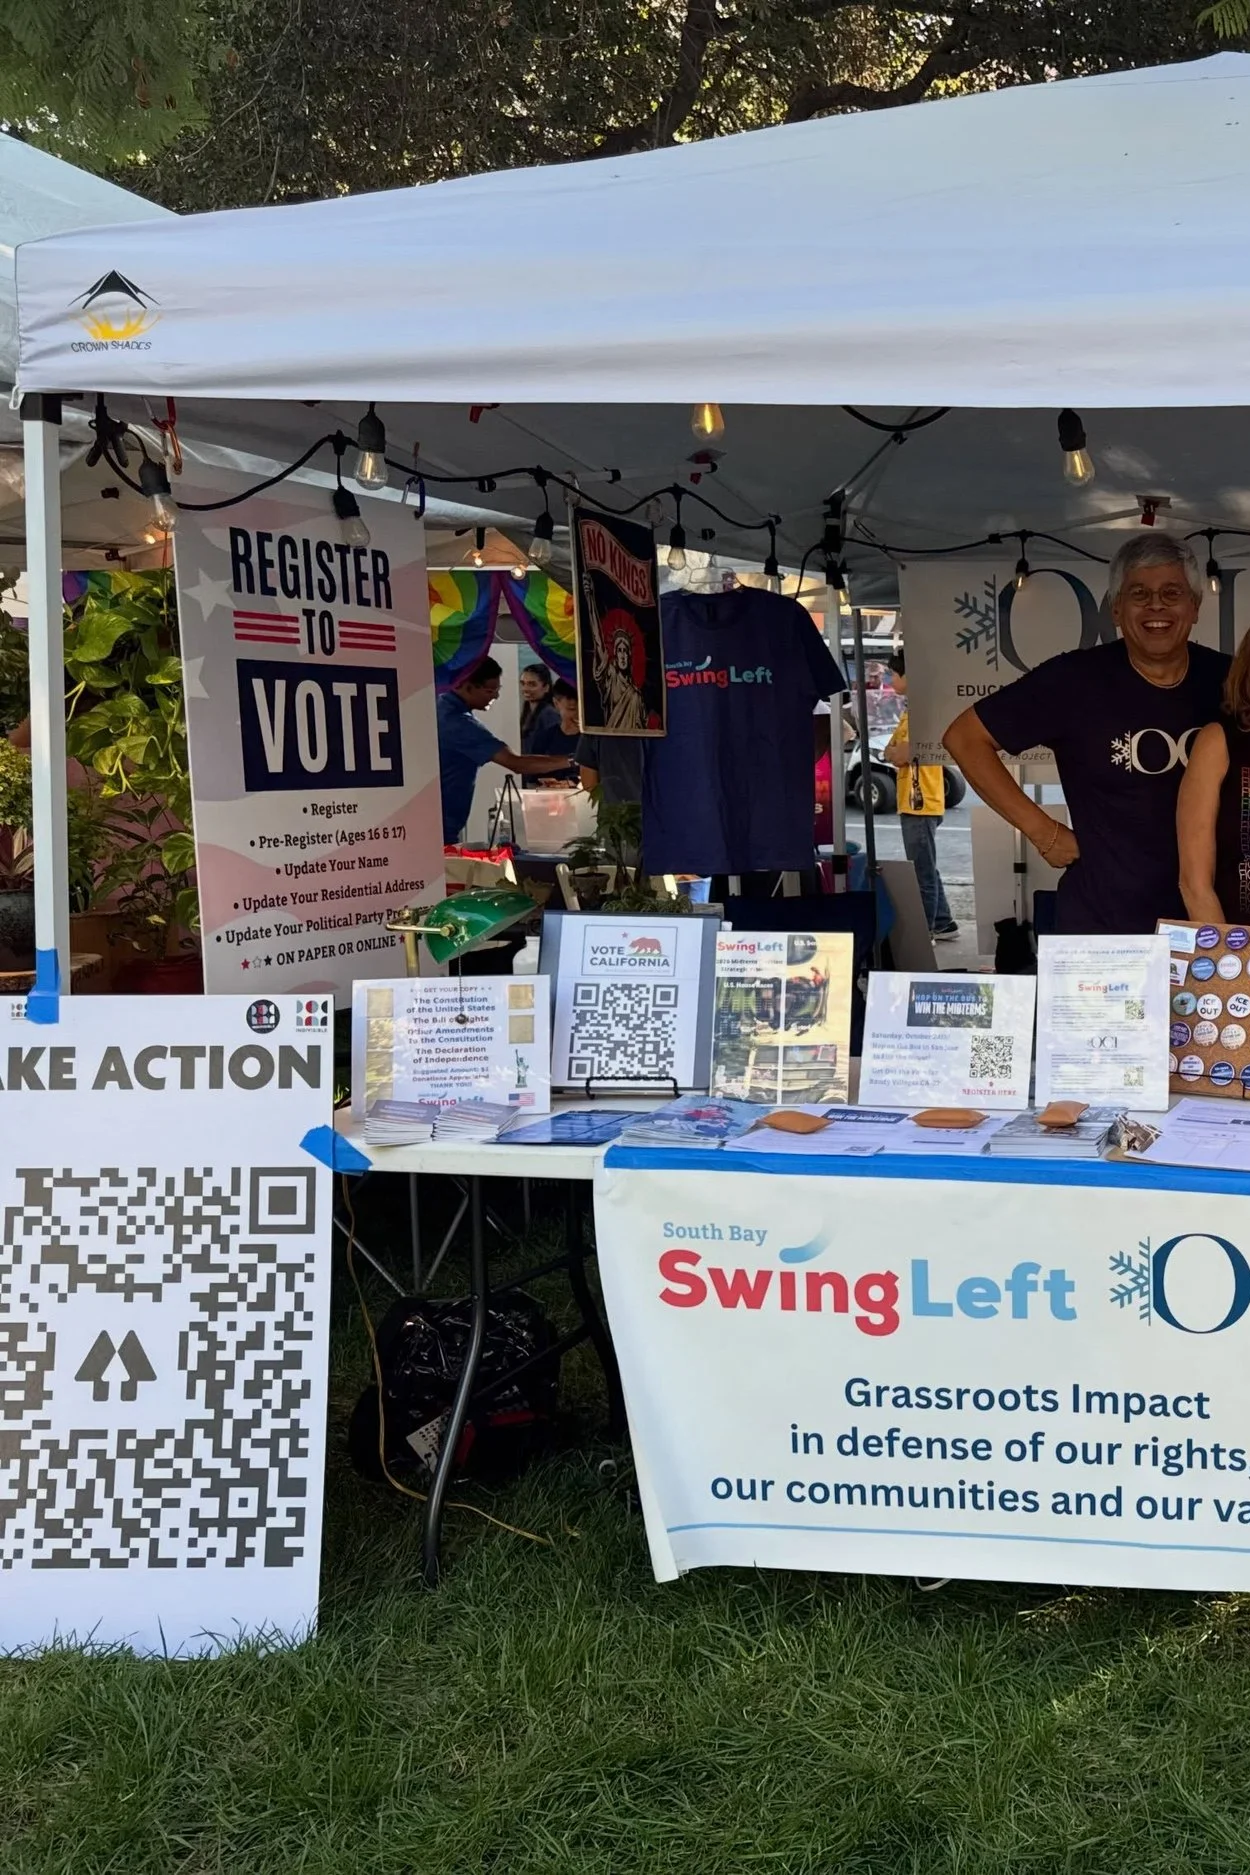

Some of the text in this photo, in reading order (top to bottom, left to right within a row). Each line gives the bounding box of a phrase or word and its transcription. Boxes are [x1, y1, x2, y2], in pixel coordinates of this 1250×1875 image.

[71, 341, 152, 352] CROWN SHADES
[229, 527, 392, 609] REGISTER
[586, 526, 648, 600] NO KINGS
[302, 608, 335, 656] TO
[665, 665, 773, 688] Swing Left
[252, 678, 392, 773] VOTE
[931, 752, 947, 761] THE
[311, 801, 358, 818] Register
[259, 825, 406, 849] Pre-Register (Ages 16 & 17)
[284, 856, 389, 879] Update Your Name
[243, 879, 425, 914] Update Your Residential Address
[226, 926, 271, 946] Update
[274, 921, 302, 936] Your
[306, 914, 353, 932] Political
[355, 909, 385, 926] Party
[277, 935, 397, 966] ON PAPER OR ONLINE
[591, 945, 625, 956] VOTE
[717, 941, 756, 955] Swing
[757, 941, 783, 952] Left
[590, 957, 670, 968] CALIFORNIA
[1078, 983, 1130, 994] Swing Left
[435, 1005, 464, 1013] United
[467, 1004, 496, 1012] States
[915, 1001, 987, 1016] WIN THE MIDTERMS
[1229, 1004, 1248, 1014] OUT
[1235, 996, 1249, 1006] ICE
[1200, 1007, 1219, 1015] OUT
[436, 1026, 495, 1034] Amendments
[438, 1034, 493, 1043] Constitution
[435, 1046, 486, 1054] Declaration
[1090, 1035, 1118, 1049] OCI
[92, 1044, 321, 1091] ACTION
[425, 1055, 489, 1064] Independence
[663, 1221, 769, 1247] South Bay
[658, 1248, 1078, 1337] Swing Left
[844, 1377, 1211, 1422] Grassroots Impact
[790, 1425, 824, 1456] in
[836, 1427, 992, 1463] defense
[1004, 1432, 1046, 1466] of
[1055, 1439, 1122, 1469] our
[710, 1475, 775, 1503] our
[786, 1477, 1041, 1515] communities
[1050, 1482, 1124, 1519] and
[1135, 1493, 1203, 1522] our
